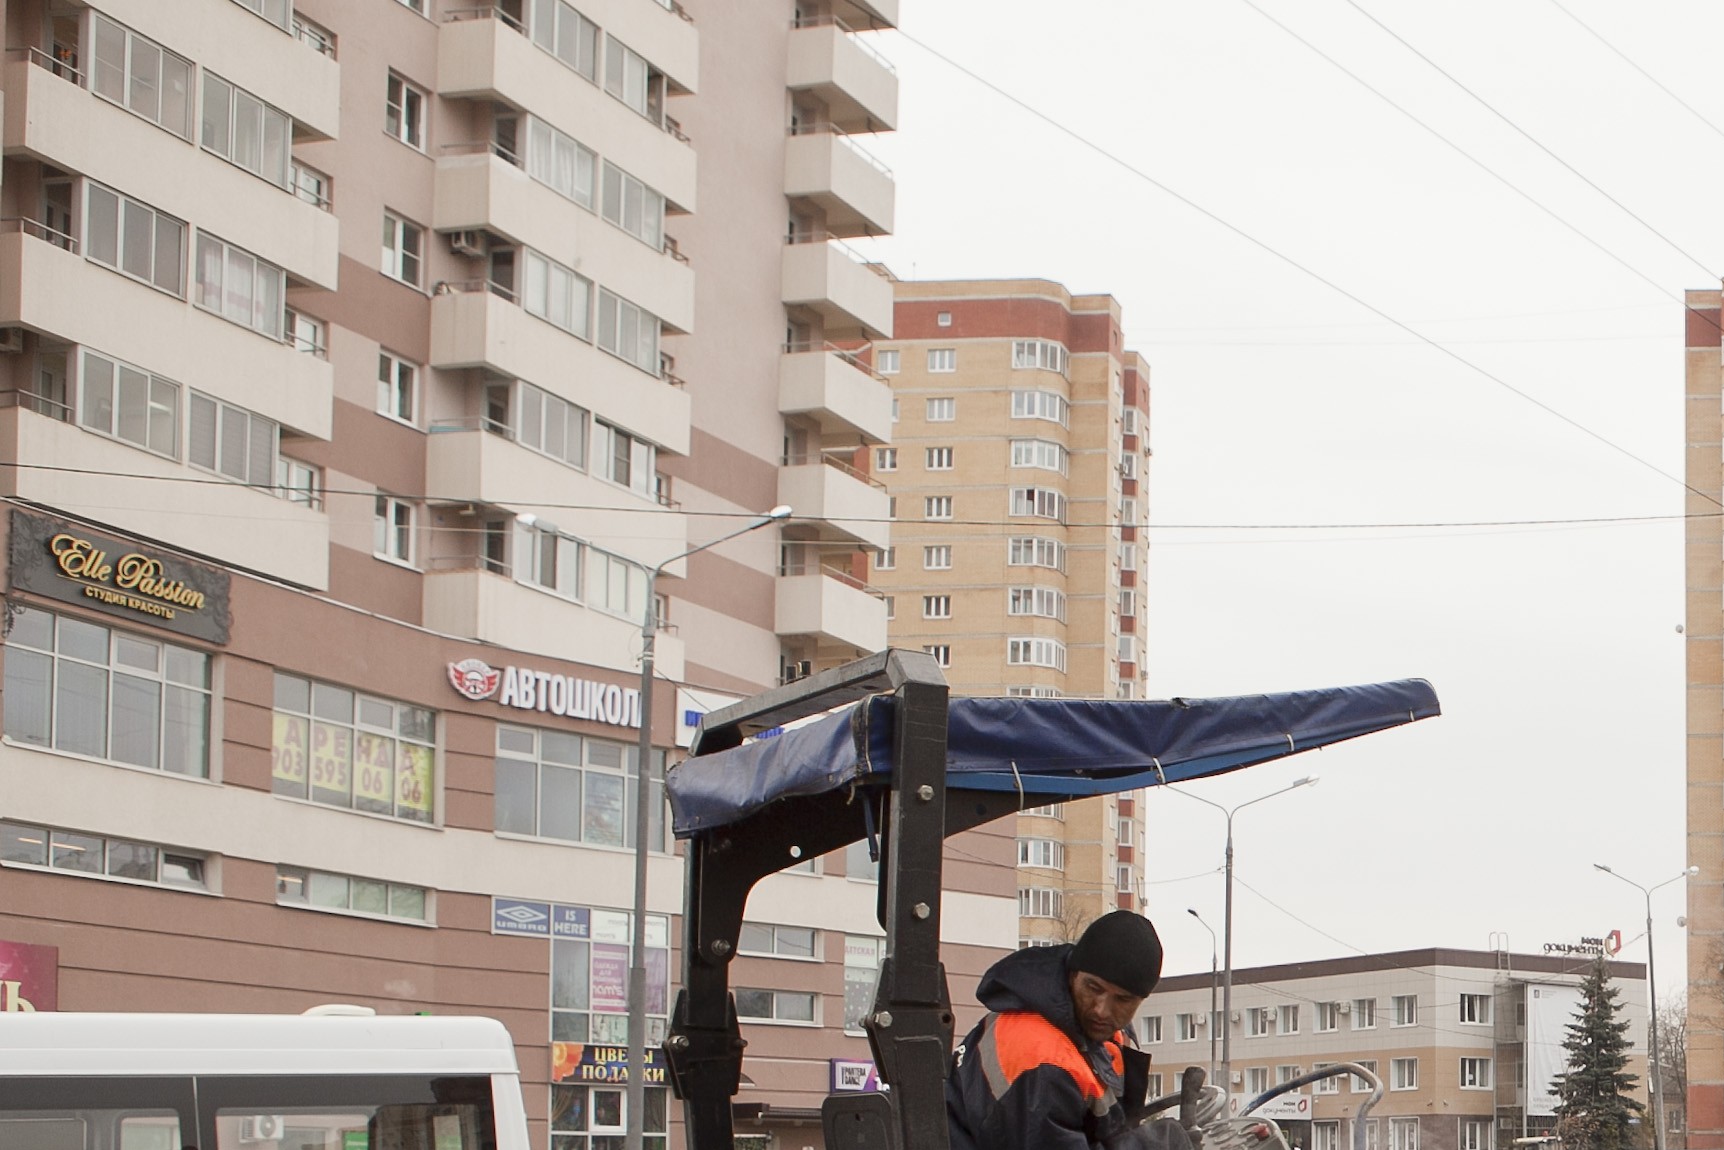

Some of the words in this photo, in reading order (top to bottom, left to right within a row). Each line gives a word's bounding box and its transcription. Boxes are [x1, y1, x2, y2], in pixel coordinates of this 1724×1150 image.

[51, 533, 112, 581] Elle
[116, 553, 205, 609] Passion
[85, 586, 126, 606] СТУДИЯ
[127, 596, 175, 619] КРАСОТЫ
[500, 665, 642, 728] АВТОШКОЛ
[284, 717, 416, 776] АРЕНДА
[315, 756, 347, 786] 595
[362, 767, 383, 795] 06
[401, 777, 422, 804] 06
[554, 922, 588, 936] HERE
[565, 910, 576, 921] IS
[594, 1047, 654, 1065] ЦВЕЫ
[582, 1064, 665, 1082] ПОДАКИ
